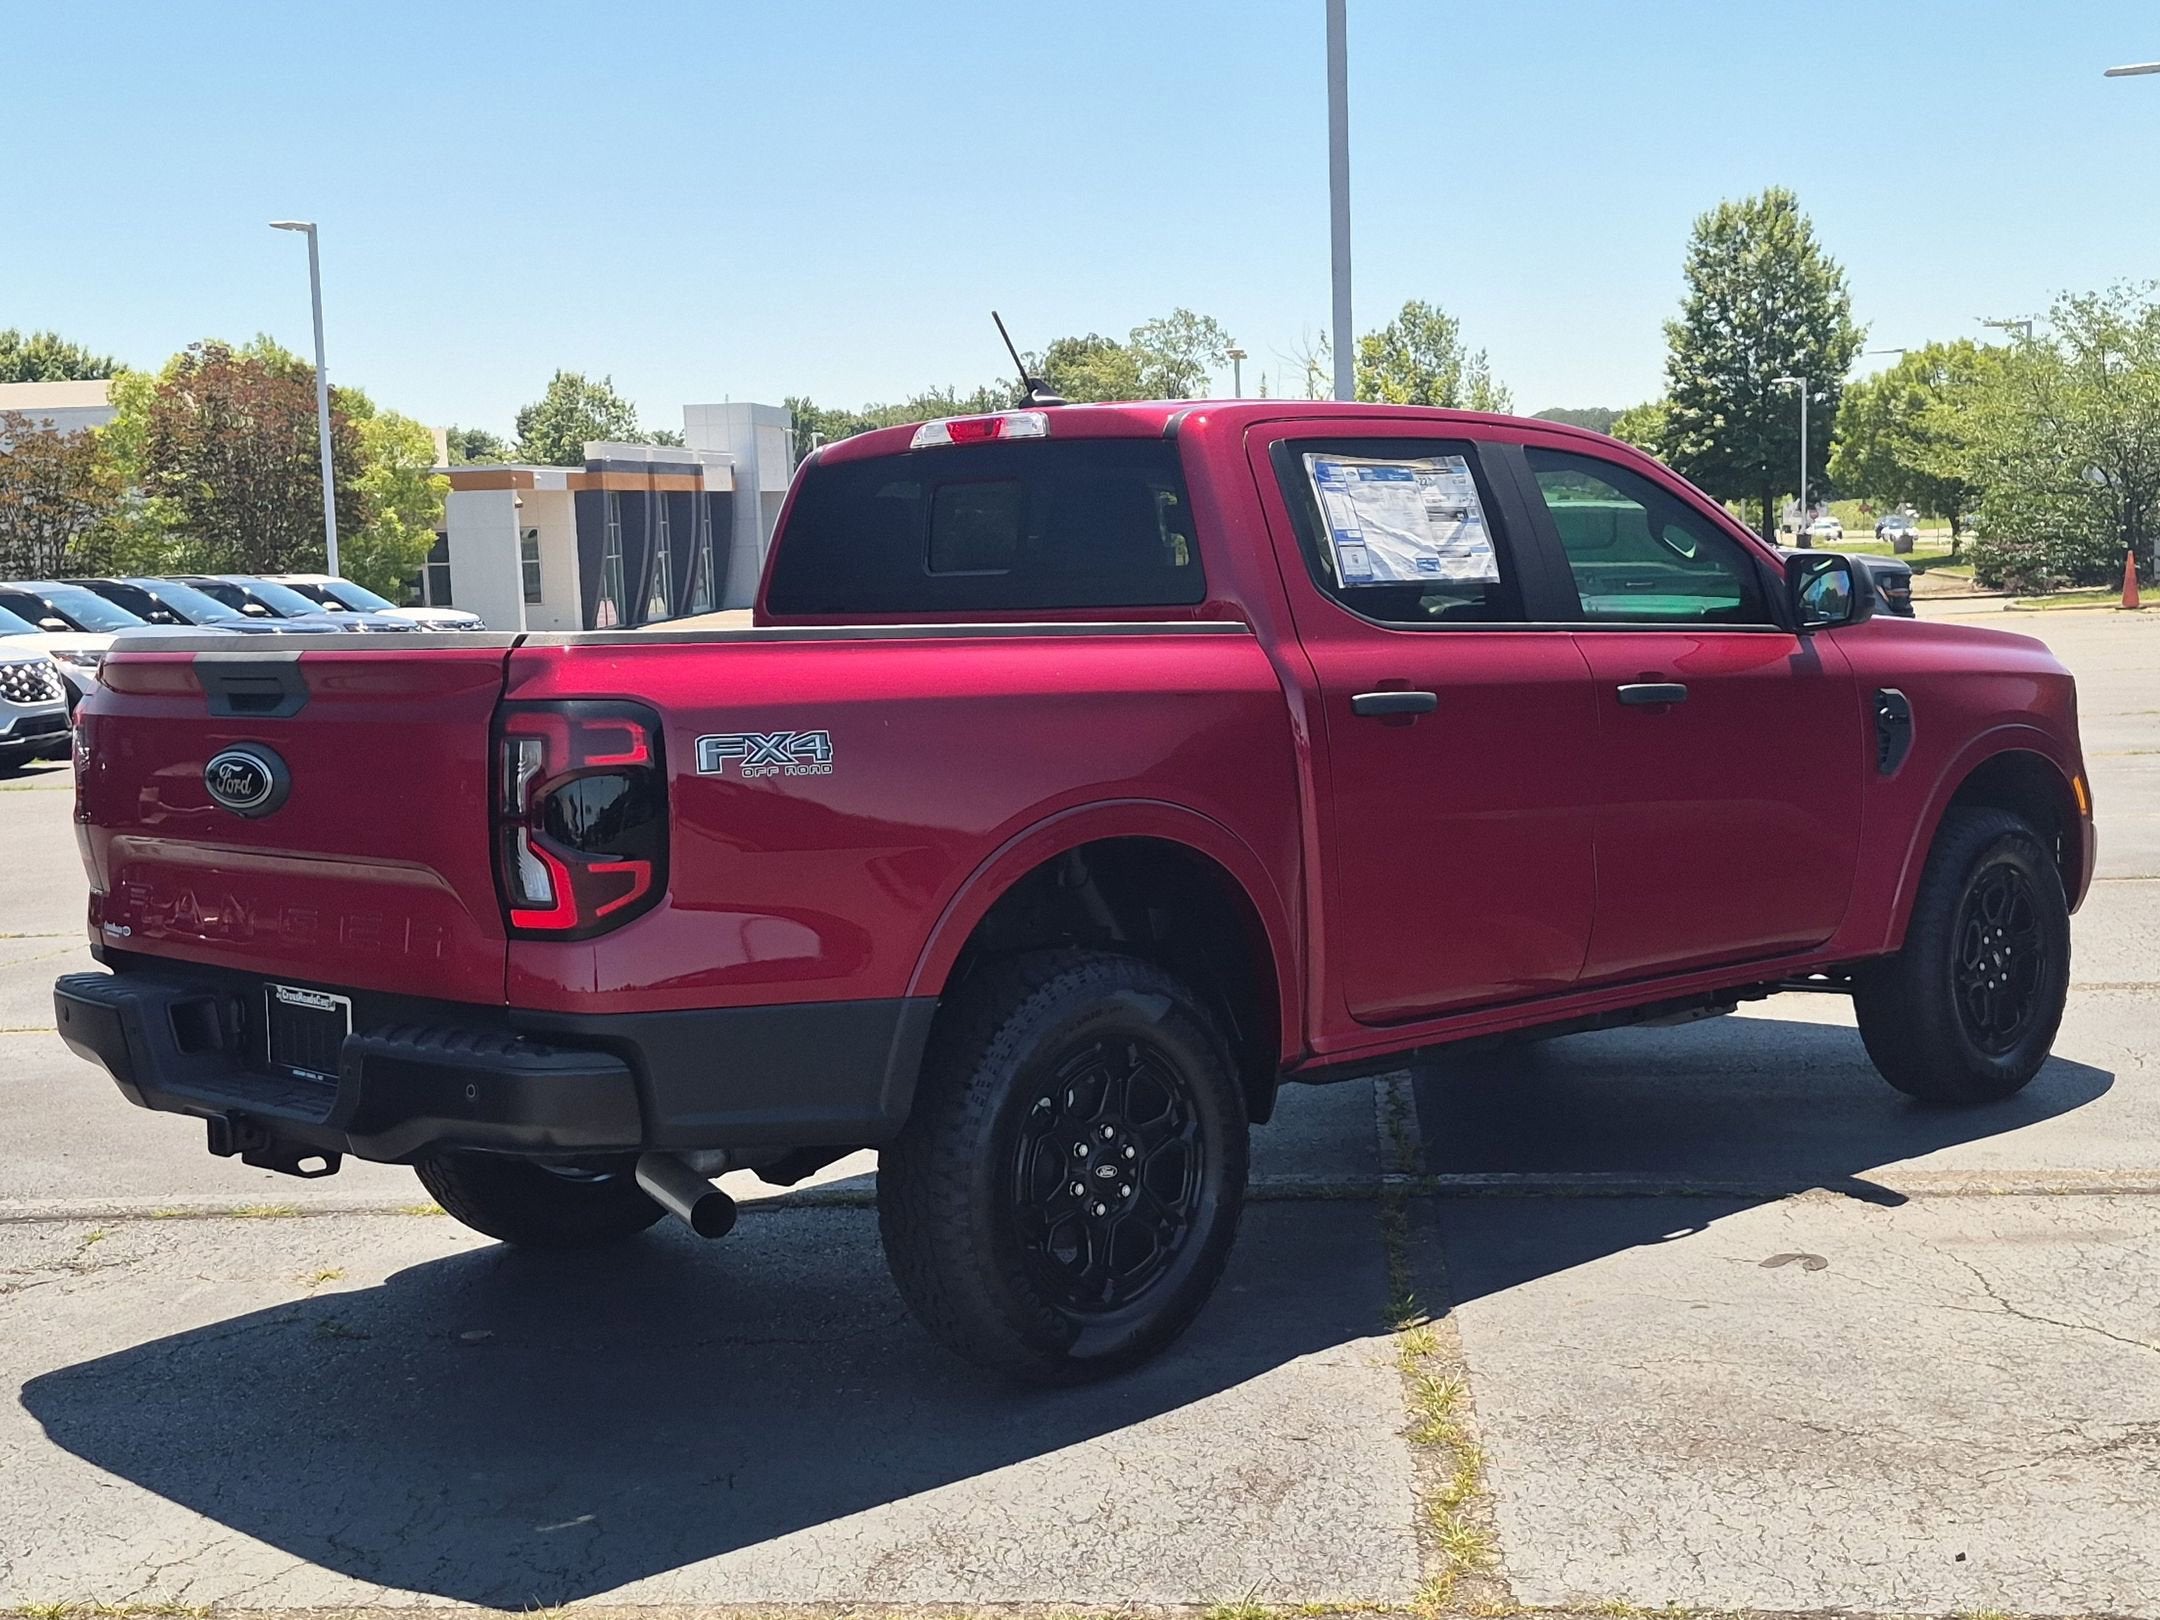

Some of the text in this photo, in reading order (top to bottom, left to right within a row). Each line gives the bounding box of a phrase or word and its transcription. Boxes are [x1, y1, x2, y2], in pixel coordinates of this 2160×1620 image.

[695, 730, 834, 775] FX4
[216, 763, 253, 795] Ford
[742, 764, 833, 777] OFF ROAD
